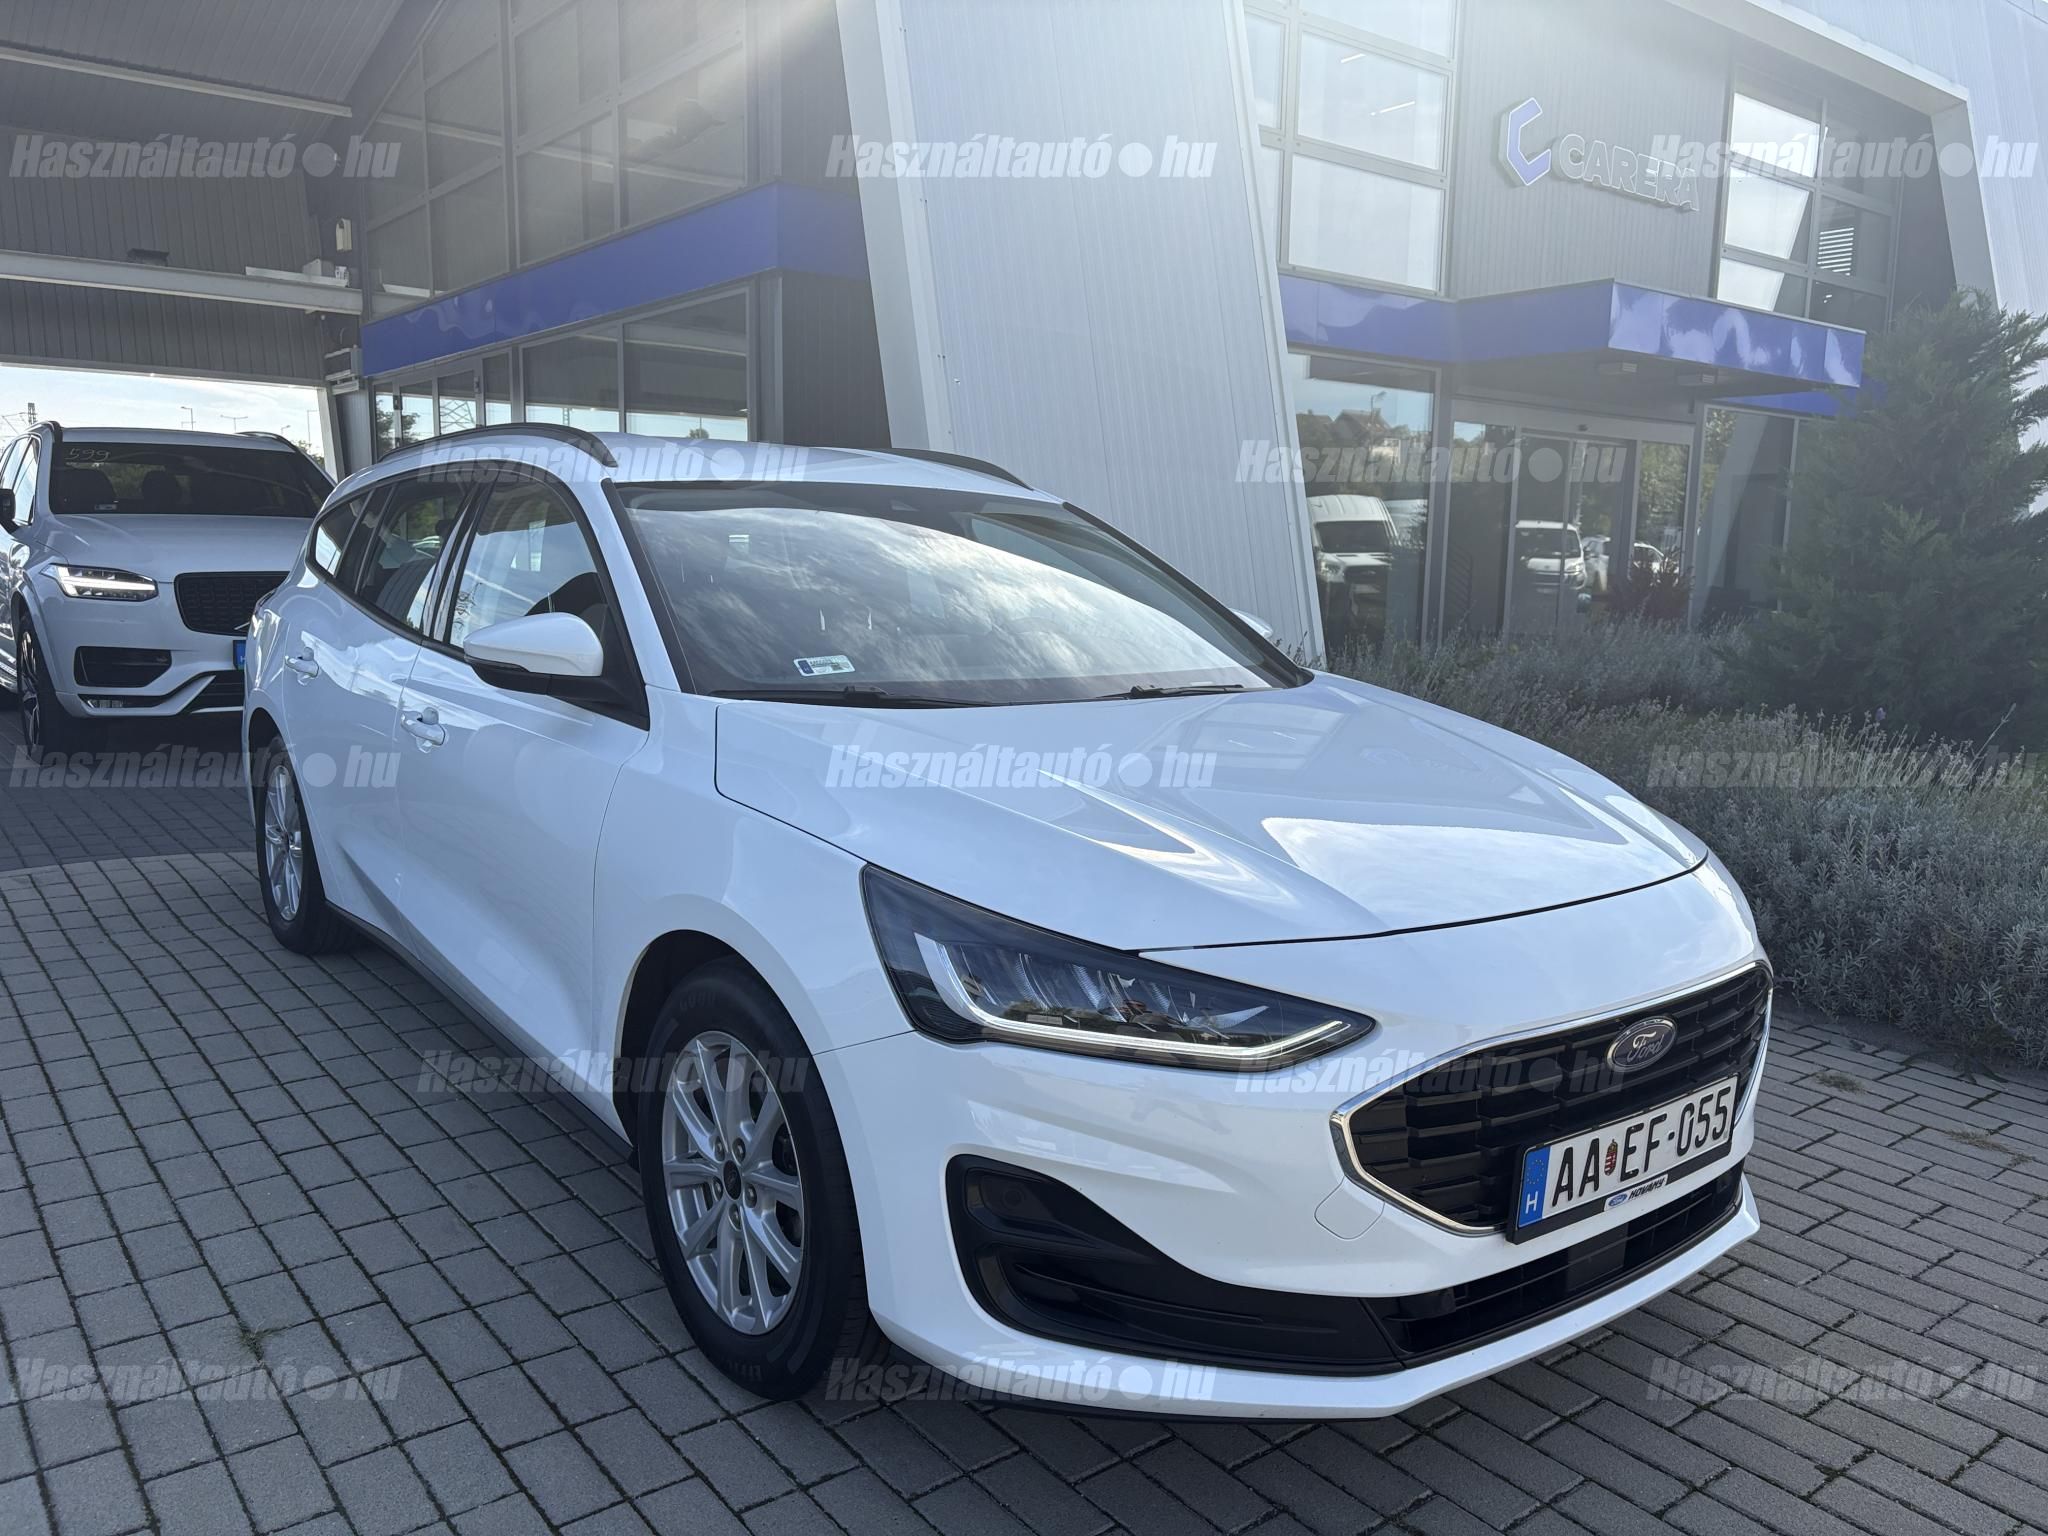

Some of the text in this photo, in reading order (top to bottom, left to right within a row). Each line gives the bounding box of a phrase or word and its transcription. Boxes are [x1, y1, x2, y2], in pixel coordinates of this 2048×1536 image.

[1556, 133, 1700, 211] CARERA
[1626, 1031, 1665, 1063] Ford
[1525, 1190, 1539, 1215] H
